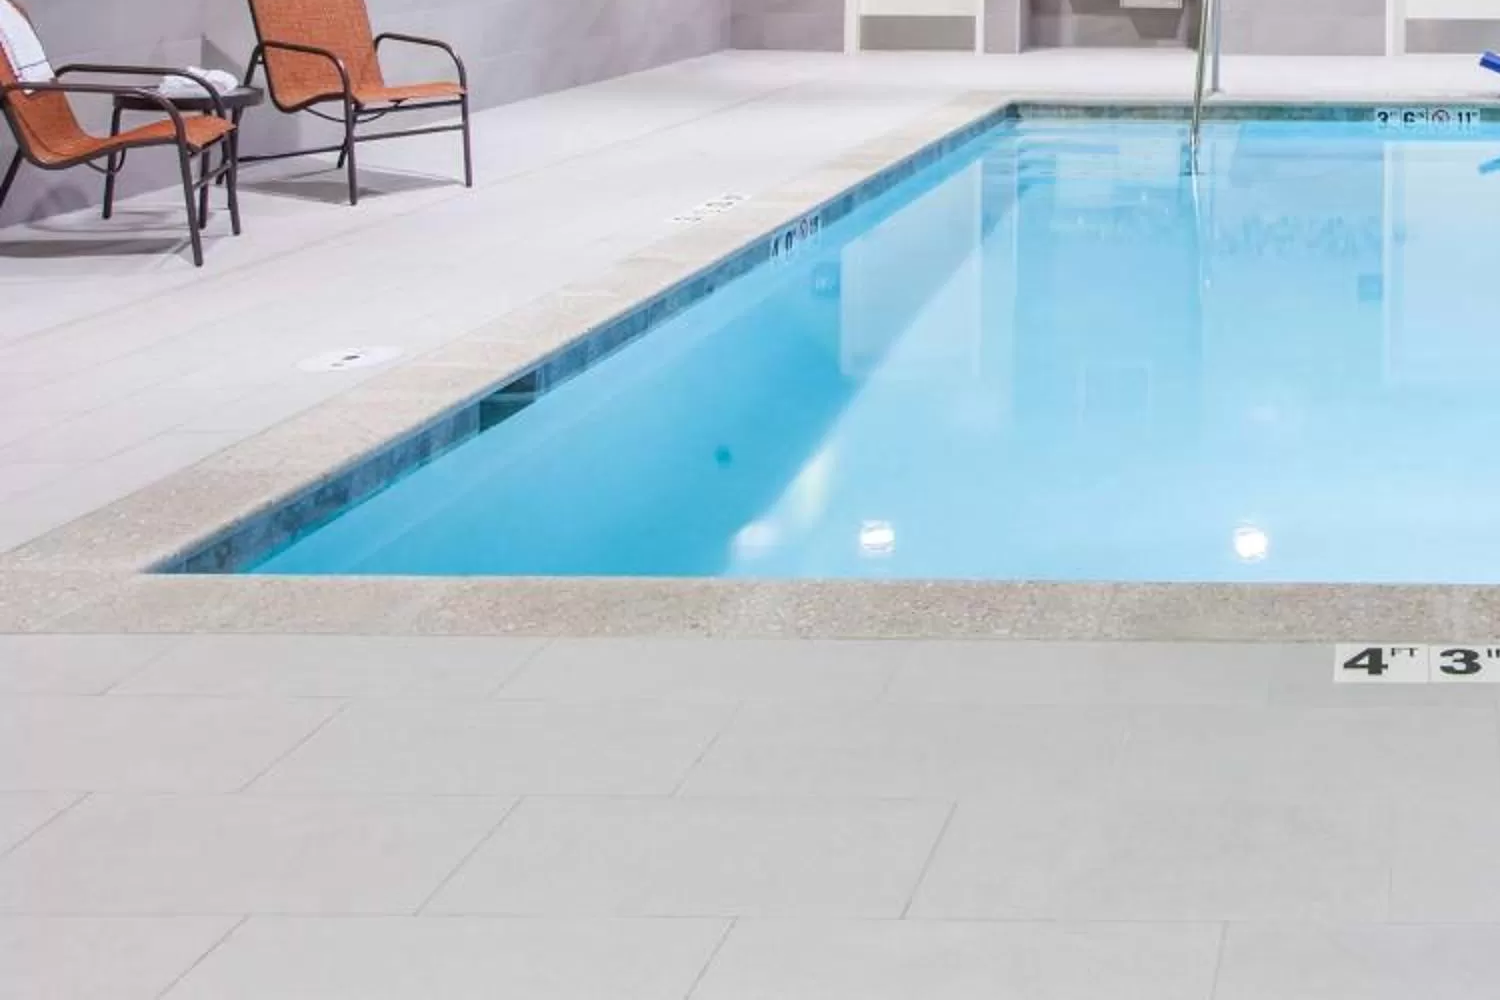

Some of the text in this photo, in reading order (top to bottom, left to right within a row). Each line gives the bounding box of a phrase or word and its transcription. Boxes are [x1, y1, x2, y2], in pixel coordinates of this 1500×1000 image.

[1343, 647, 1389, 675] 4
[1391, 647, 1418, 657] FT
[1440, 648, 1482, 675] 3
